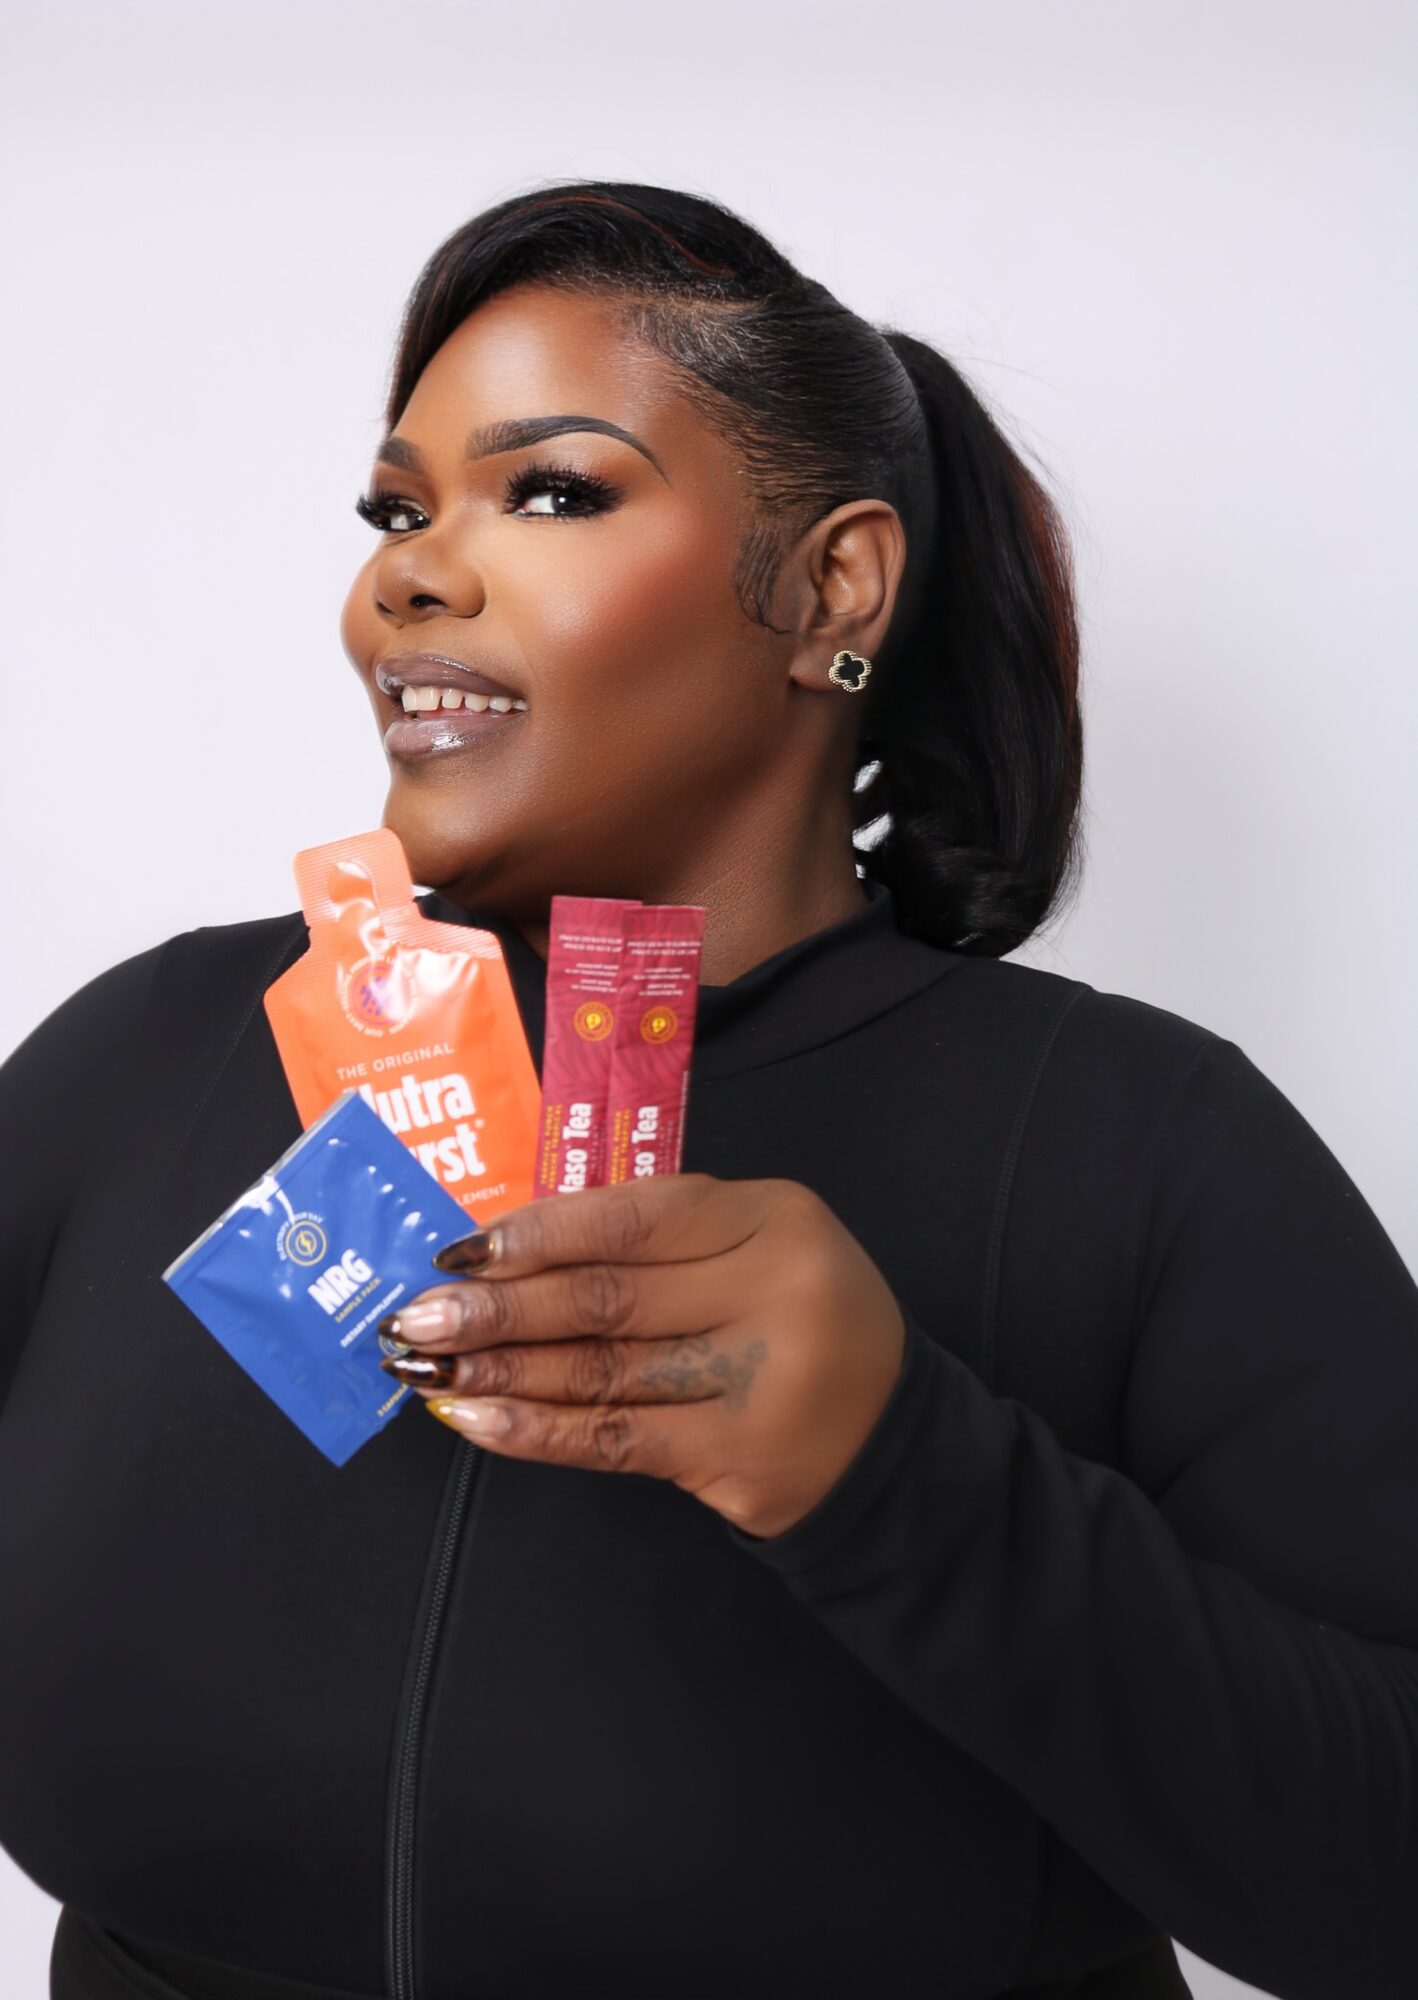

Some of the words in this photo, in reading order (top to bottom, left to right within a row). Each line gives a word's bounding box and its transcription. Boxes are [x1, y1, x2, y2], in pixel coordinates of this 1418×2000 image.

[336, 1063, 368, 1081] THE
[372, 1042, 455, 1072] ORIGINAL
[562, 1103, 593, 1140] Tea
[631, 1105, 659, 1143] Tea
[407, 1123, 487, 1182] rst
[610, 1146, 620, 1185] ROPICAL
[634, 1151, 656, 1177] so
[455, 1183, 507, 1206] LEMENT
[307, 1248, 373, 1315] NRG
[335, 1295, 362, 1323] SAMPLE
[361, 1277, 381, 1298] PACK
[340, 1320, 367, 1348] DIETARY
[365, 1282, 405, 1324] SUPPLEMENT
